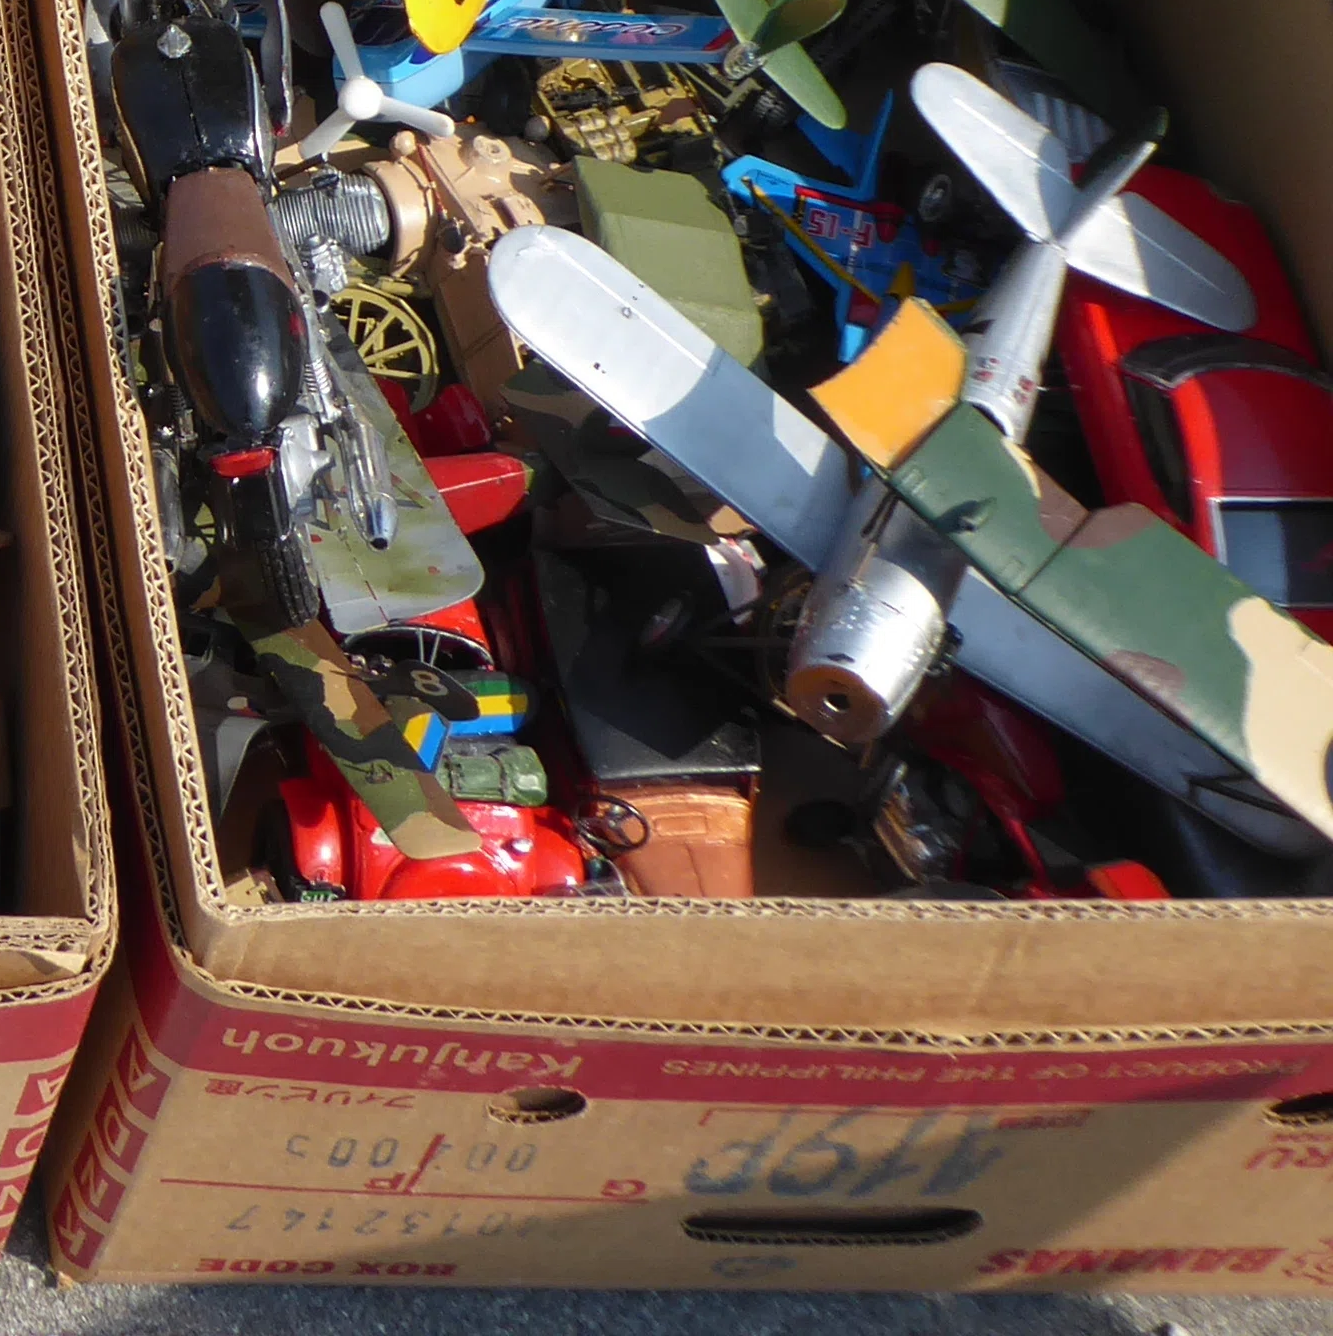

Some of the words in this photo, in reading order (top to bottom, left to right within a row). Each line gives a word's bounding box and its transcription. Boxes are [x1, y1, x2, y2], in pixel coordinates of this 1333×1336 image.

[805, 207, 875, 249] F-15
[410, 669, 449, 697] 8
[218, 1025, 584, 1079] Kanjukuoh
[659, 1056, 927, 1084] PHILIPPINES
[933, 1063, 1016, 1084] THE
[1026, 1062, 1090, 1081] OF
[1096, 1056, 1309, 1082] PRODUCT
[203, 1077, 416, 1111] フィリピン産
[363, 1173, 408, 1192] P
[599, 1178, 648, 1199] G
[599, 1178, 648, 1200] G
[192, 1257, 336, 1275] CODE
[350, 1260, 459, 1277] BOX
[974, 1246, 1288, 1277] BANANAS
